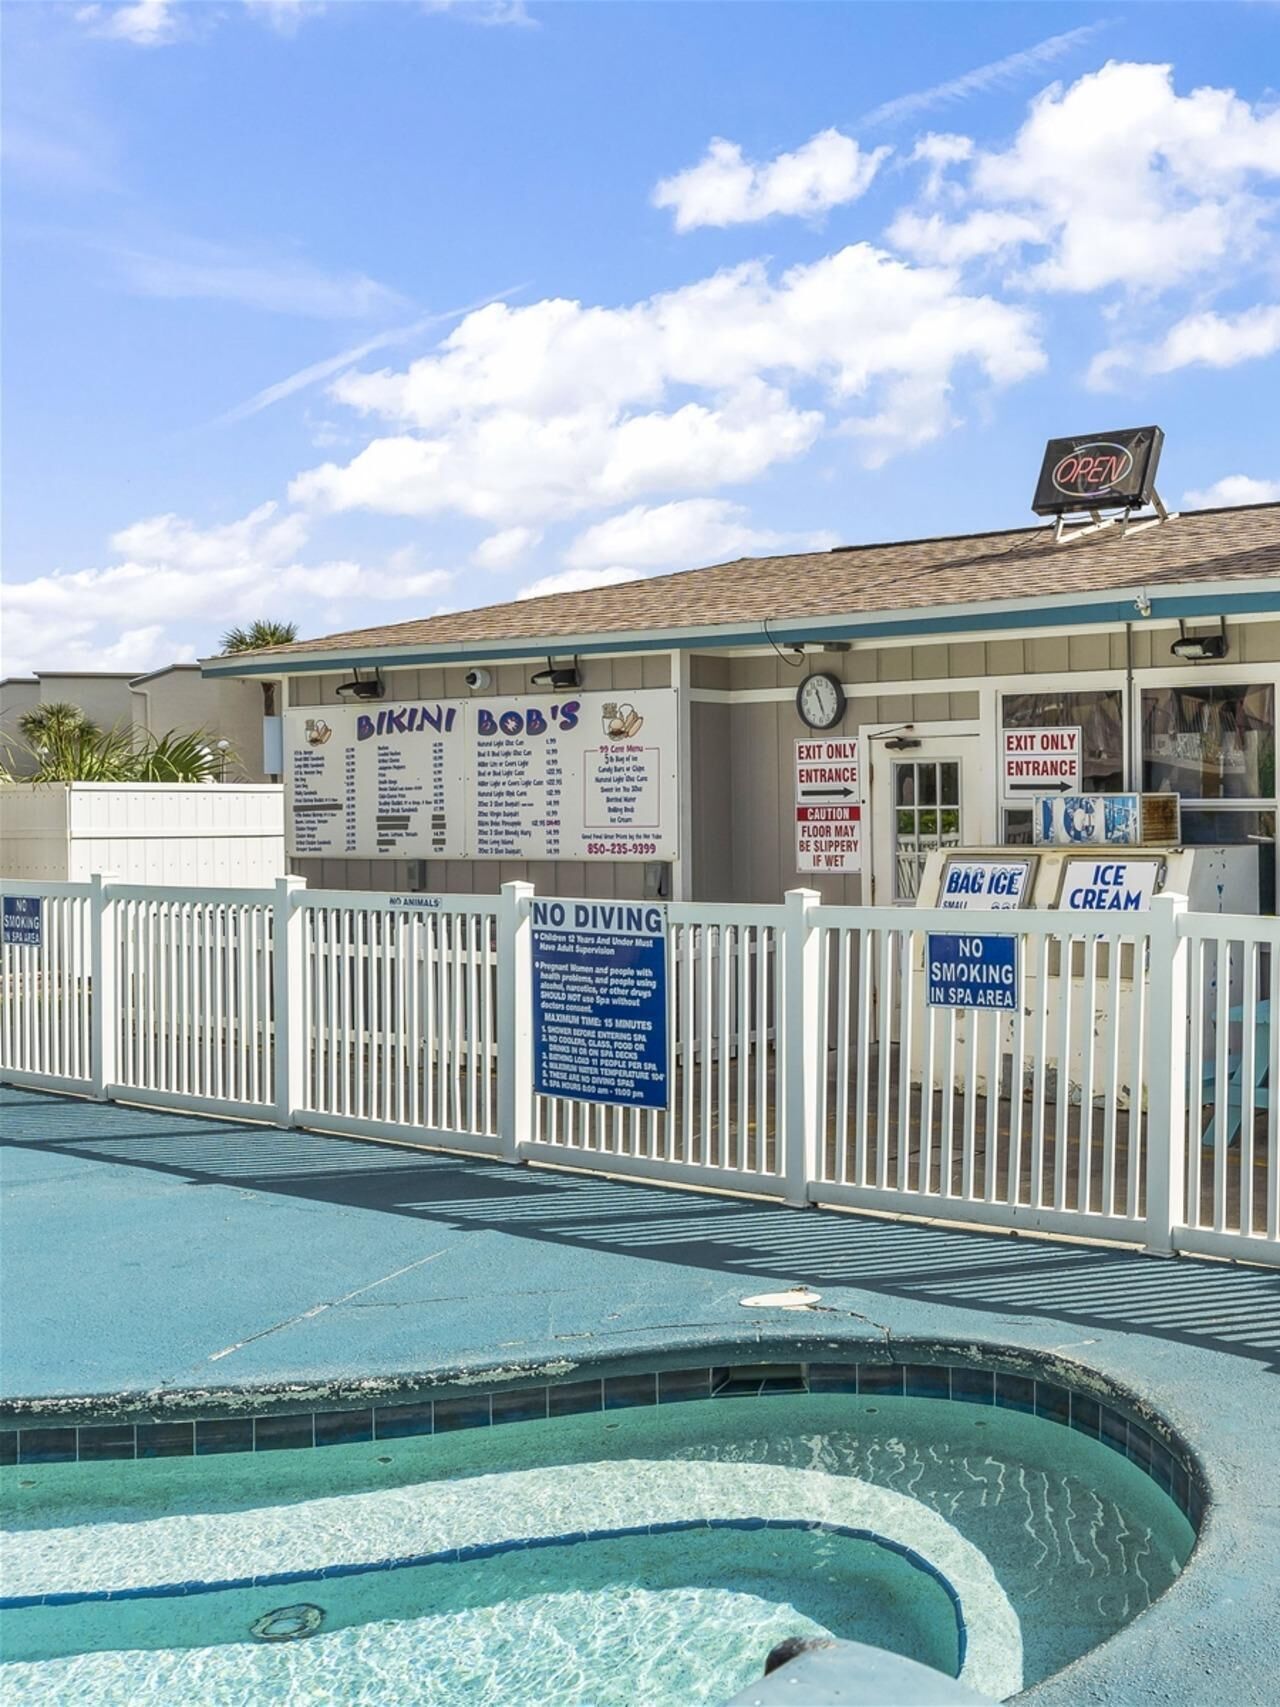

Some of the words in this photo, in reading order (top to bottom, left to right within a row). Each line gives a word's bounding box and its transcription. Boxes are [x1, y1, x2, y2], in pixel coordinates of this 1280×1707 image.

[1056, 455, 1128, 483] OPEN
[357, 703, 457, 742] BIKINI
[477, 700, 581, 736] BOB'S
[600, 745, 609, 753] 99
[610, 745, 625, 753] Cent
[626, 744, 644, 753] Menu
[1006, 735, 1036, 751] EXIT
[1040, 734, 1077, 751] ONLY
[798, 744, 823, 760] EXIT
[826, 743, 857, 759] ONLY
[798, 767, 857, 784] ENTRANCE
[1007, 760, 1077, 776] ENTRANCE
[807, 808, 850, 820] CAUTION
[801, 825, 832, 838] FLOOR
[834, 825, 856, 837] MAY
[587, 843, 657, 855] 850-235-9399
[798, 840, 812, 852] BE
[813, 840, 858, 852] SLIPPERY
[812, 855, 822, 867] IF
[824, 855, 845, 867] WET
[947, 867, 984, 894] BAG
[986, 867, 1023, 895] ICE
[1092, 865, 1127, 886] ICE
[15, 899, 28, 912] NO
[403, 898, 440, 907] ANIMALS
[1069, 889, 1142, 910] CREAM
[534, 902, 566, 927] NO
[575, 904, 662, 933] DIVING
[540, 932, 566, 942] Children
[596, 936, 610, 945] And
[612, 937, 634, 946] Under
[635, 938, 654, 948] Must
[958, 938, 983, 957] NO
[540, 942, 556, 952] Have
[557, 944, 574, 952] Adult
[576, 944, 616, 956] Supervision
[540, 961, 569, 972] Pregnant
[595, 965, 608, 974] and
[610, 966, 634, 977] people
[636, 968, 654, 977] with
[931, 961, 1014, 985] SMOKING
[540, 972, 560, 980] health
[595, 975, 608, 984] and
[610, 977, 635, 988] people
[636, 979, 656, 990] using
[540, 991, 566, 1000] SHOULD
[568, 993, 582, 1002] NOT
[596, 996, 610, 1006] Spa
[612, 997, 640, 1006] without
[566, 984, 598, 994] narcotics,
[610, 986, 628, 996] other
[630, 988, 652, 998] drugs
[930, 986, 944, 1002] IN
[948, 987, 973, 1004] SPA
[976, 989, 1013, 1006] AREA
[541, 1001, 564, 1010] doctors
[544, 1012, 580, 1025] MAXIMUM
[604, 1018, 614, 1028] 15
[615, 1019, 652, 1031] MINUTES
[547, 1026, 572, 1035] SHOWER
[573, 1028, 596, 1038] BEFORE
[597, 1030, 632, 1040] ENTERING
[633, 1033, 647, 1042] SPA
[548, 1034, 558, 1043] NO
[614, 1042, 634, 1050] FOOD
[634, 1043, 645, 1052] OR
[549, 1043, 570, 1052] DRINKS
[572, 1045, 578, 1054] IN
[579, 1046, 588, 1055] OR
[588, 1048, 599, 1056] ON
[600, 1049, 614, 1058] SPA
[616, 1050, 638, 1060] DECKS
[592, 1058, 598, 1066] 11
[600, 1059, 626, 1068] PEOPLE
[628, 1061, 642, 1070] PER
[644, 1062, 658, 1072] SPA
[549, 1070, 568, 1080] THESE
[568, 1073, 580, 1082] ARE
[581, 1074, 590, 1083] NO
[592, 1076, 616, 1086] DIVING
[617, 1078, 635, 1088] SPAS
[600, 1068, 650, 1080] TEMPERATURE
[549, 1080, 560, 1089] SPA
[562, 1081, 581, 1091] HOURS
[632, 1090, 644, 1098] pm
